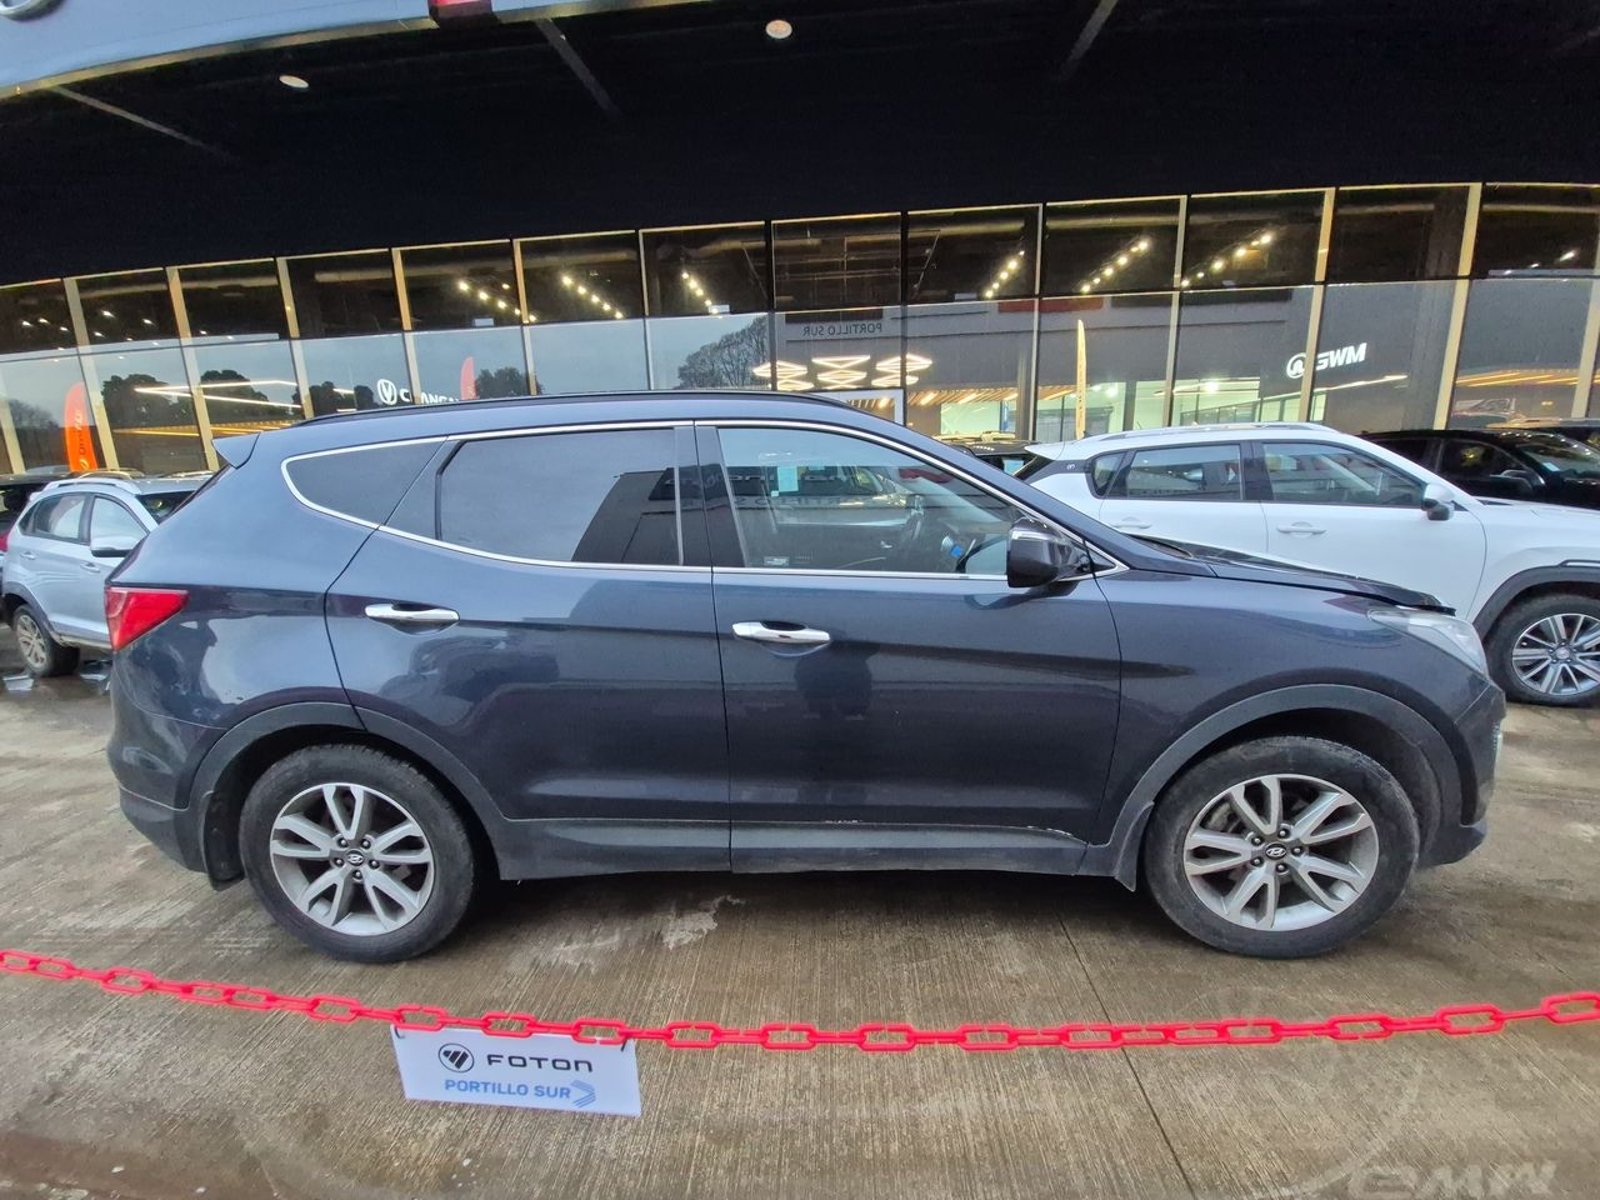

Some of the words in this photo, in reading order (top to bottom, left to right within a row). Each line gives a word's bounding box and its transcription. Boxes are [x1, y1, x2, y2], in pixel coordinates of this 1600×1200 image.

[1316, 342, 1368, 371] GWM
[444, 1079, 529, 1097] PORTILLO
[534, 1085, 571, 1099] SUR
